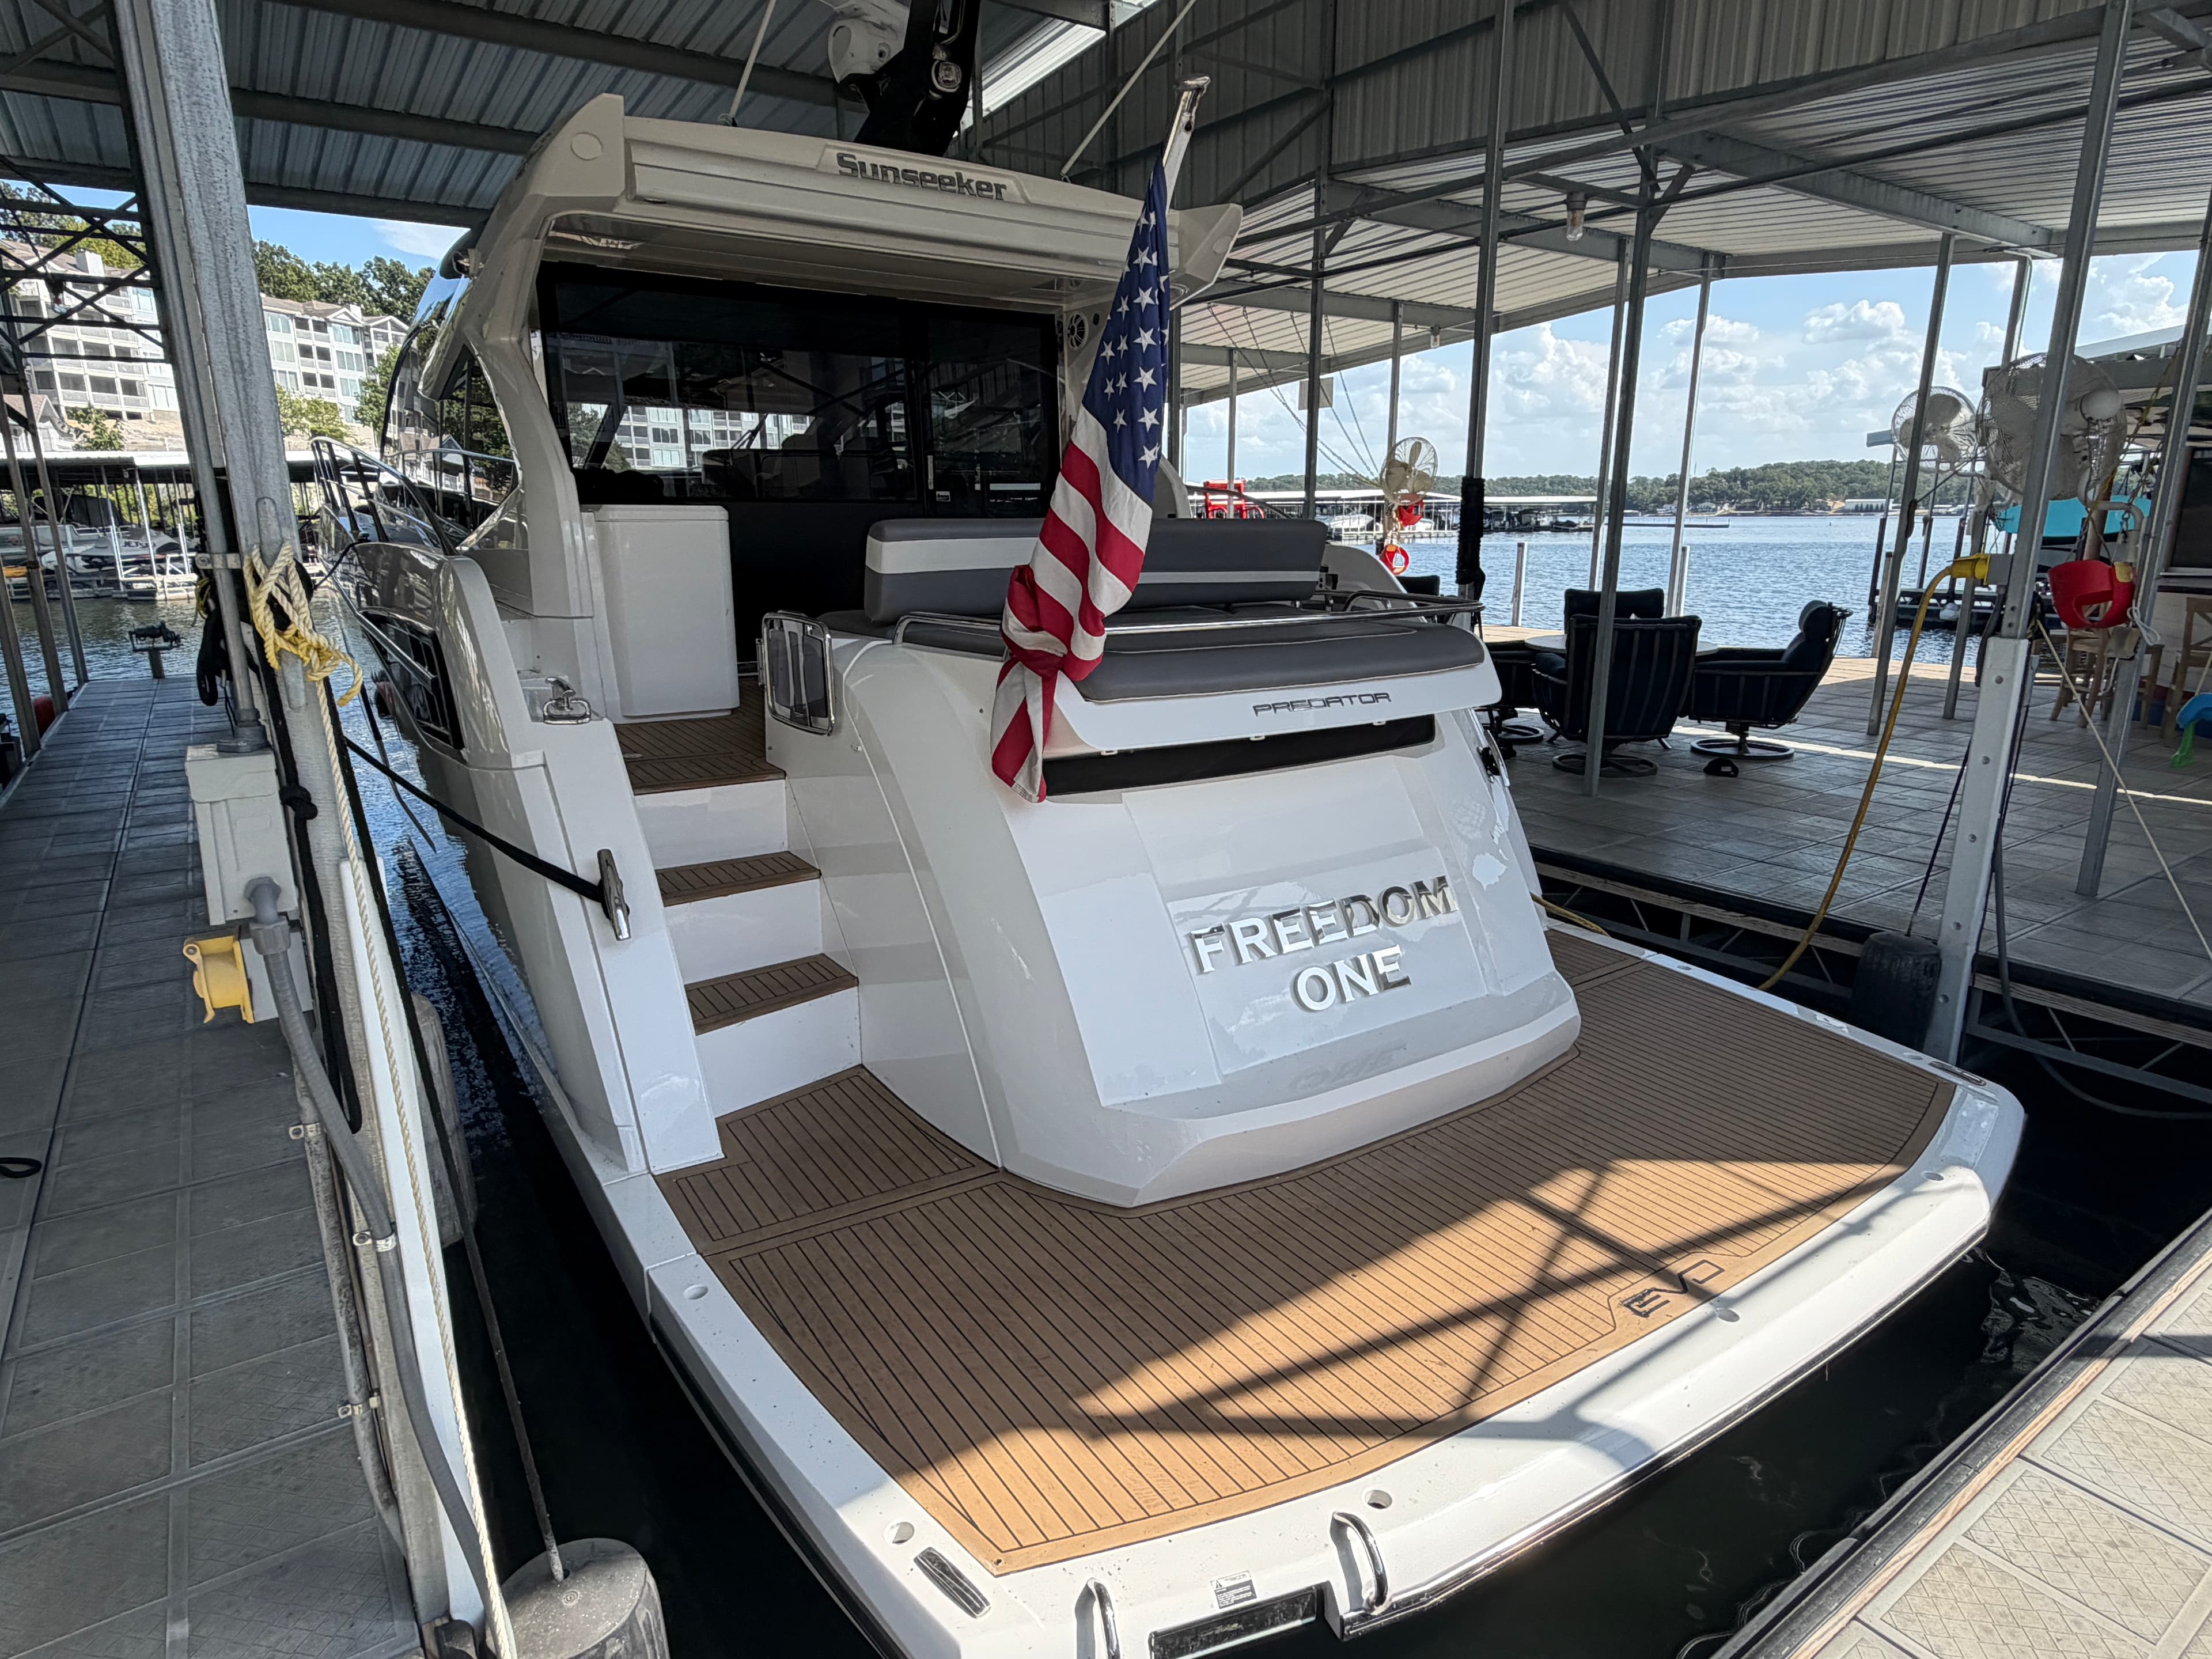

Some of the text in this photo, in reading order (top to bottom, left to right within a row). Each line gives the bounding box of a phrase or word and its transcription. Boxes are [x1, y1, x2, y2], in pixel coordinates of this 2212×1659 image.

[836, 152, 1007, 200] Sunseeker
[1252, 692, 1392, 717] PREDATOR
[1190, 876, 1459, 973] FREEDOM
[1290, 944, 1411, 1012] ONE
[1619, 1259, 1725, 1318] EVO
